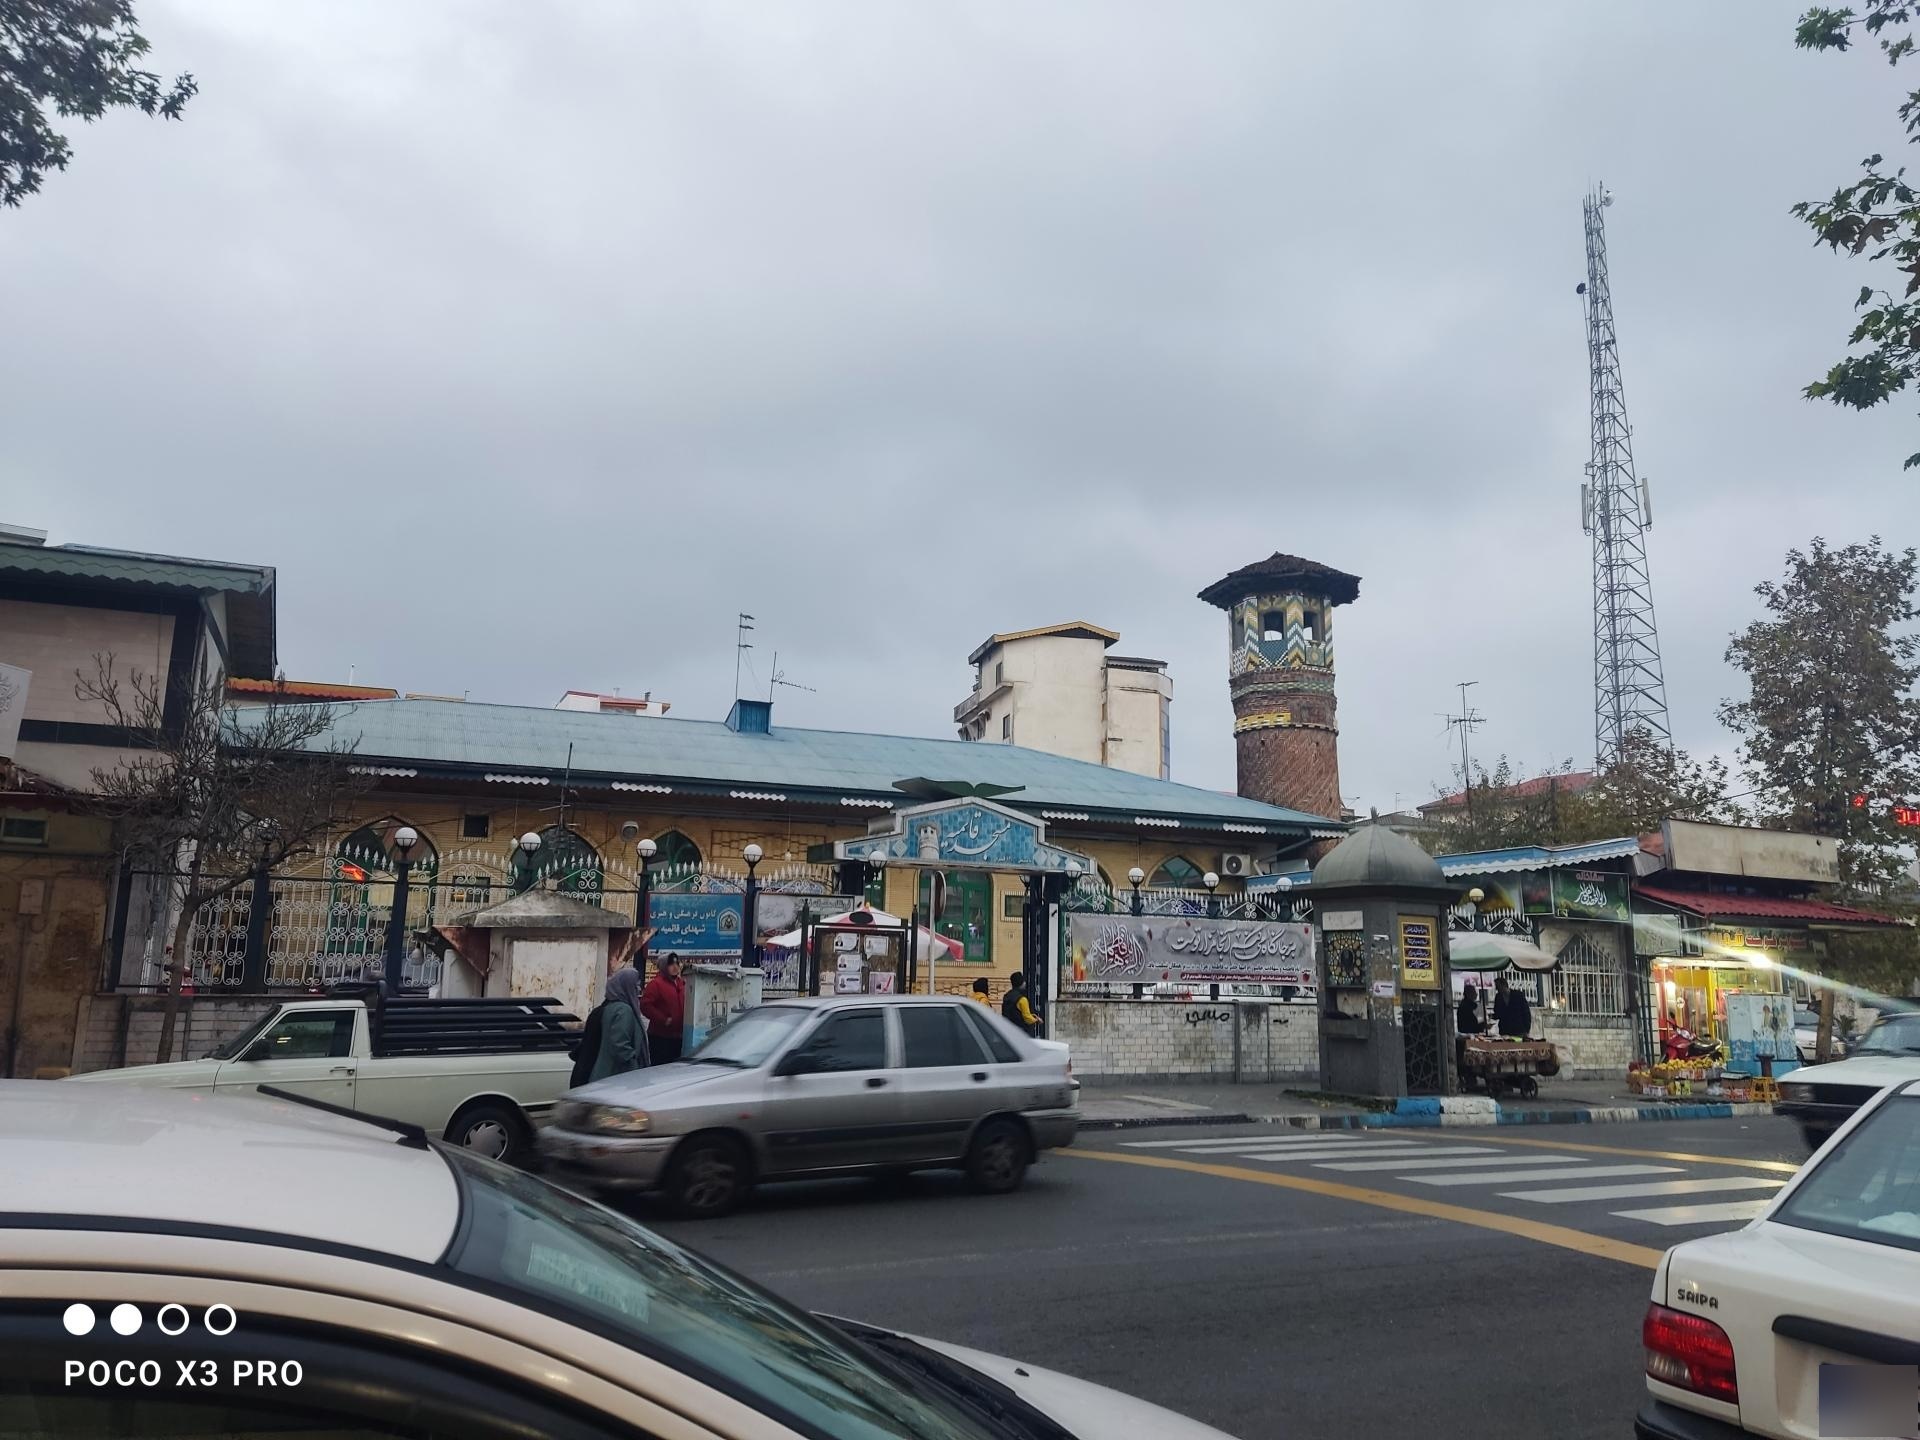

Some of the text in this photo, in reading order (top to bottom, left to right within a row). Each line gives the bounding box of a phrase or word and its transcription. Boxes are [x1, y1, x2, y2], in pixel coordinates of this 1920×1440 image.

[947, 821, 1011, 861] مسجد
[674, 909, 698, 920] فرهنگی
[680, 923, 706, 935] شهدای
[1677, 1288, 1719, 1310] SAIPA
